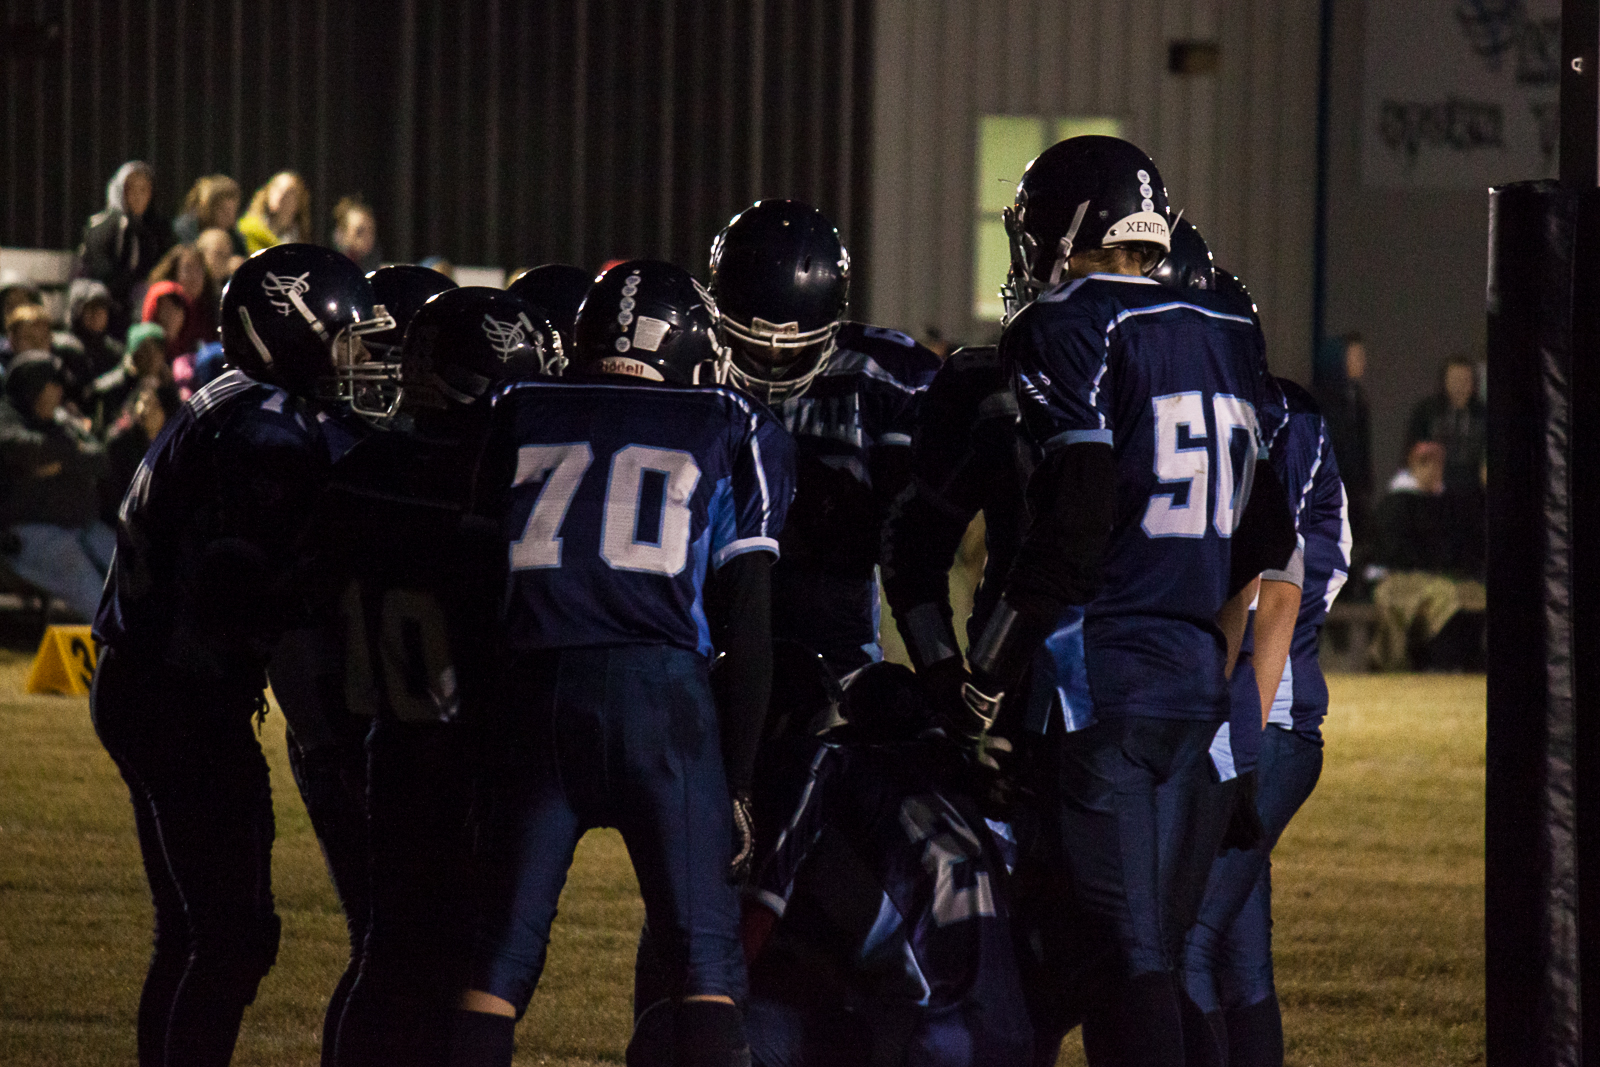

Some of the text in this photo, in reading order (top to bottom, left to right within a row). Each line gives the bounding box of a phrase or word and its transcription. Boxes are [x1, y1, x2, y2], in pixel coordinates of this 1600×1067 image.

[1126, 221, 1166, 237] XENITH
[508, 441, 702, 577] 70
[1140, 390, 1258, 539] 50
[340, 578, 458, 722] 10
